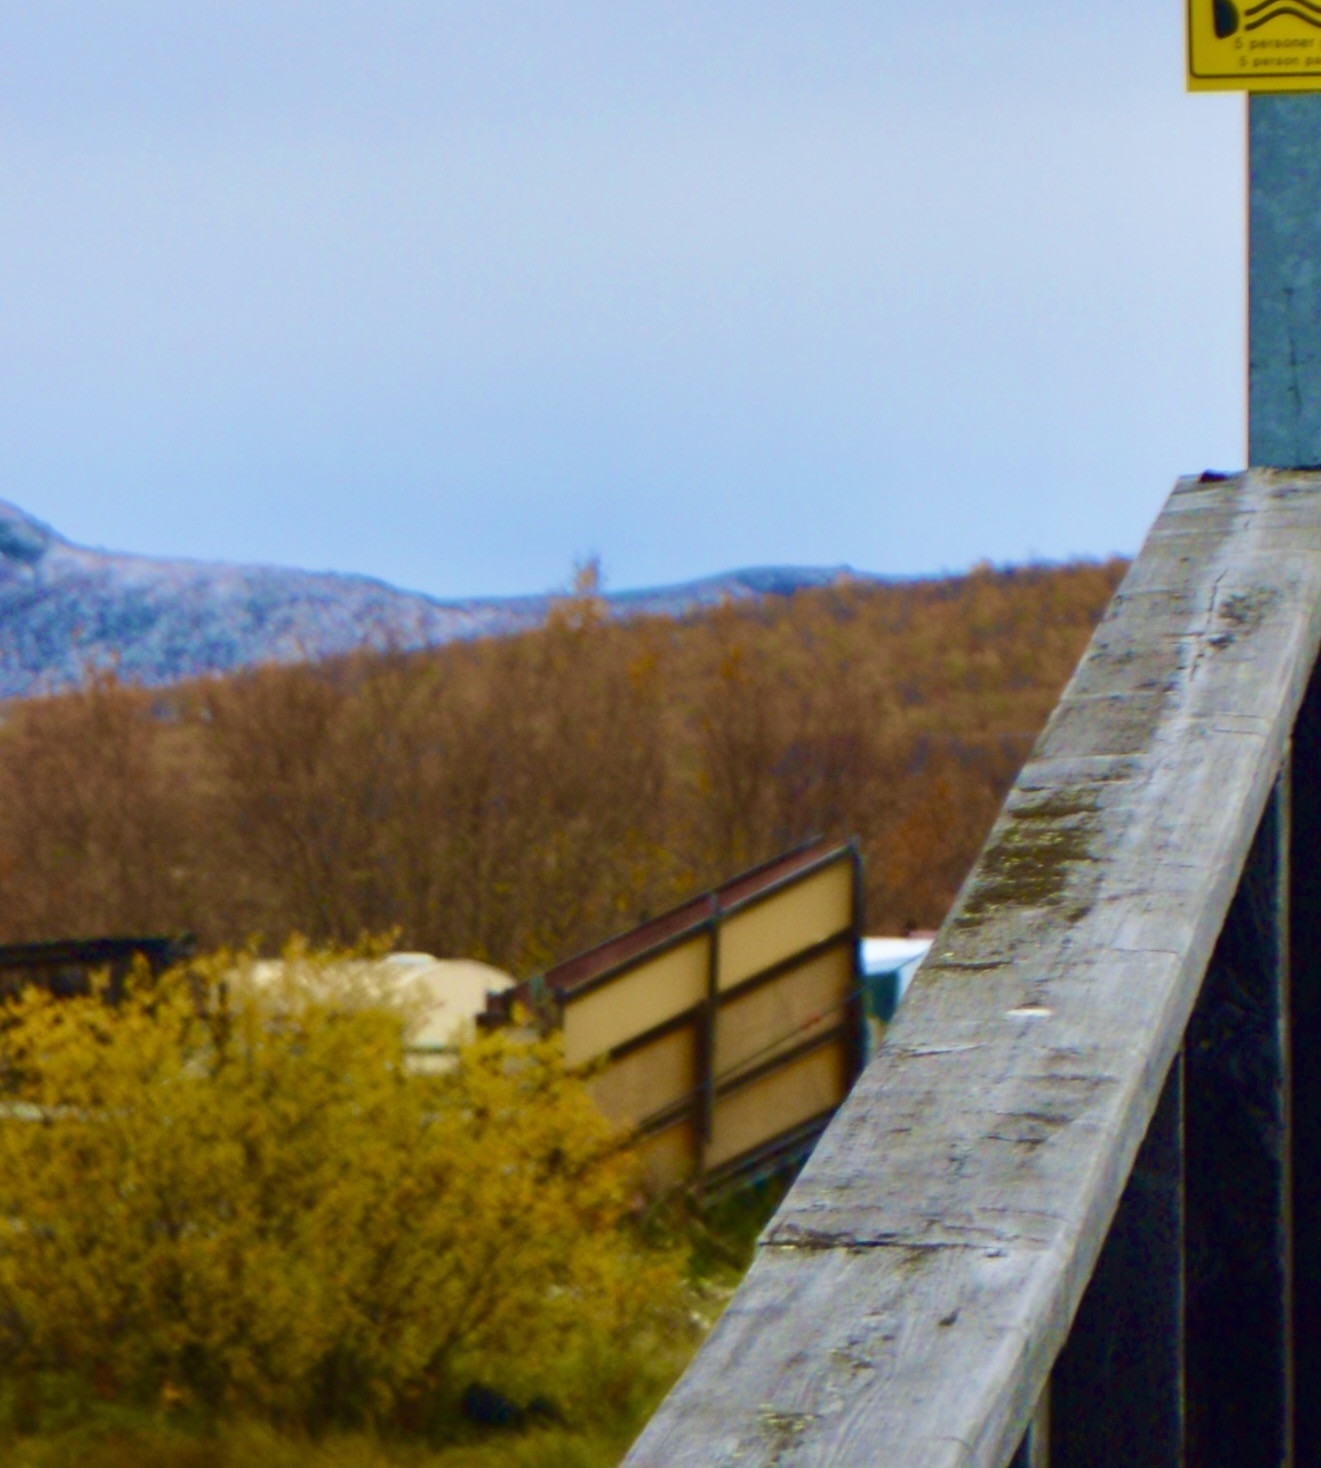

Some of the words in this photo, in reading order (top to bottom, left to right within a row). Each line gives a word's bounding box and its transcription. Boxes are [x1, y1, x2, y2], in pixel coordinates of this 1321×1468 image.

[1235, 37, 1243, 49] 5
[1249, 38, 1314, 51] personer
[1239, 55, 1247, 67] 5
[1253, 56, 1300, 68] person
